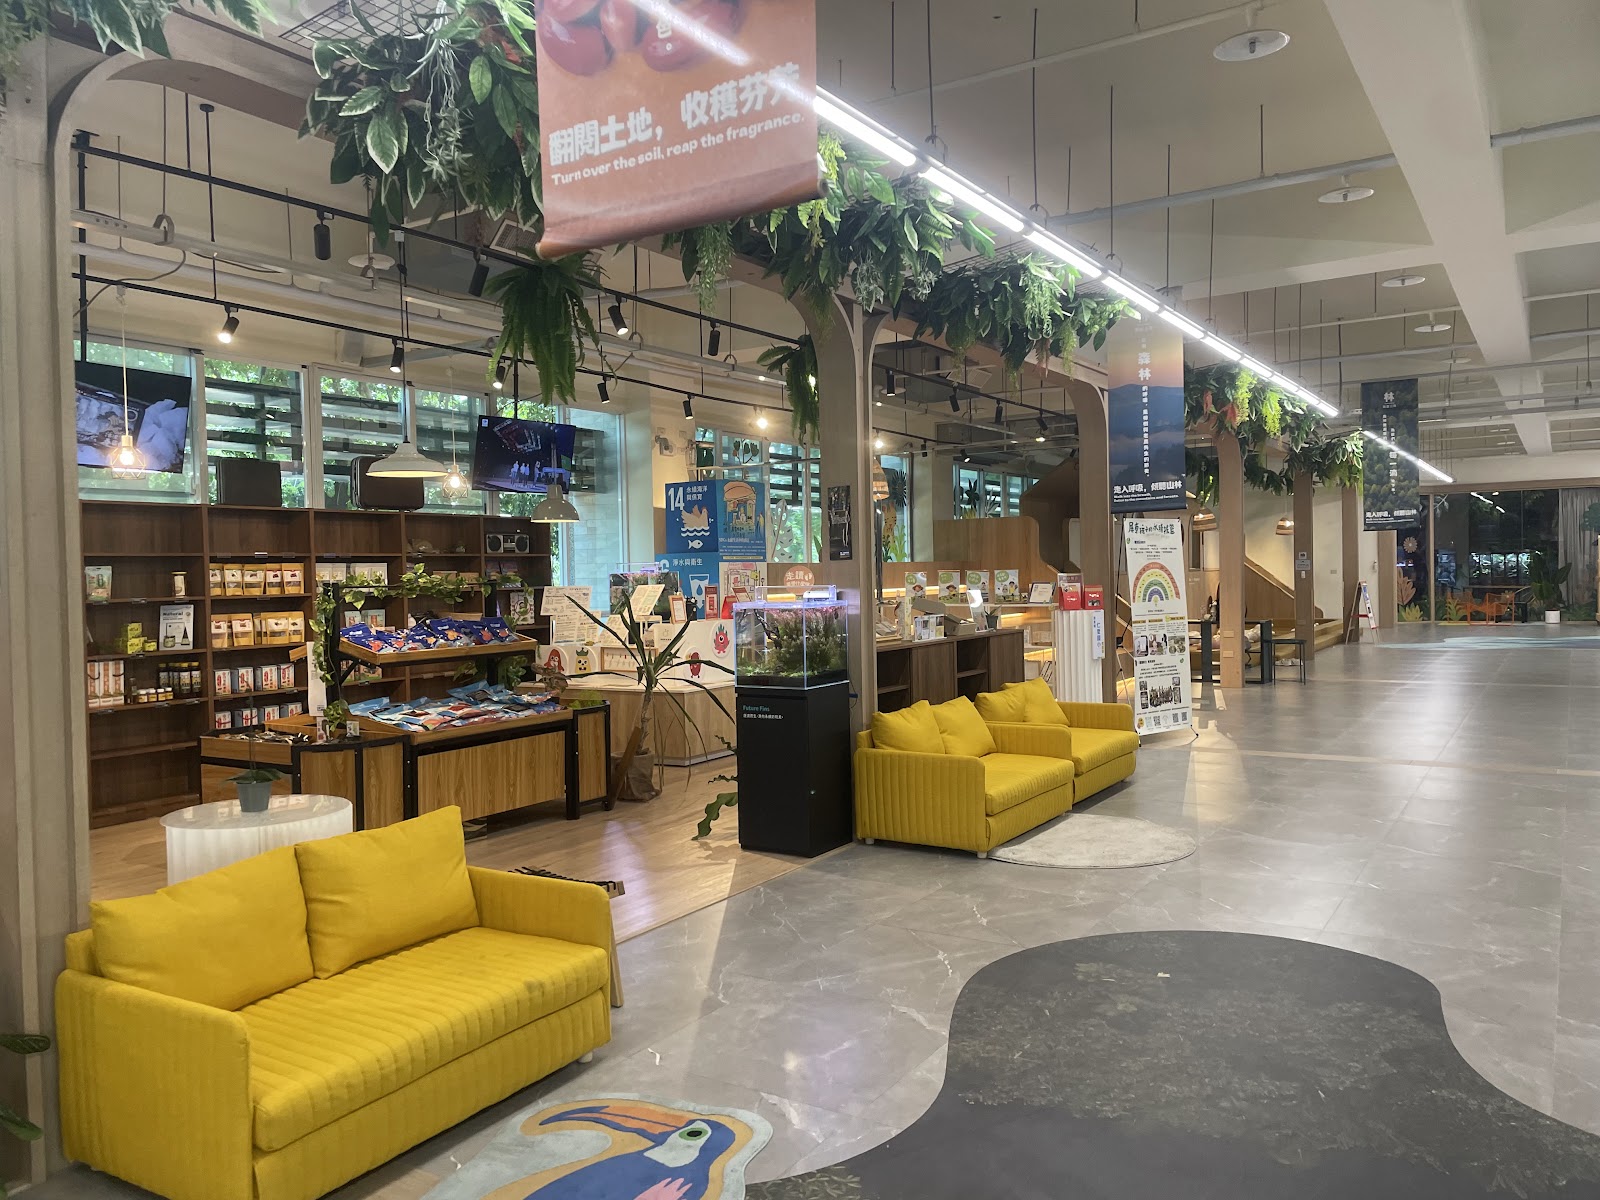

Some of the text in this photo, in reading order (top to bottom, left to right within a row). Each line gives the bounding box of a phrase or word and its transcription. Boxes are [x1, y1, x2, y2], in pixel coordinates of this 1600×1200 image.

[551, 112, 805, 186] Turn over the soil, reap the fragrance.
[668, 486, 685, 512] 14
